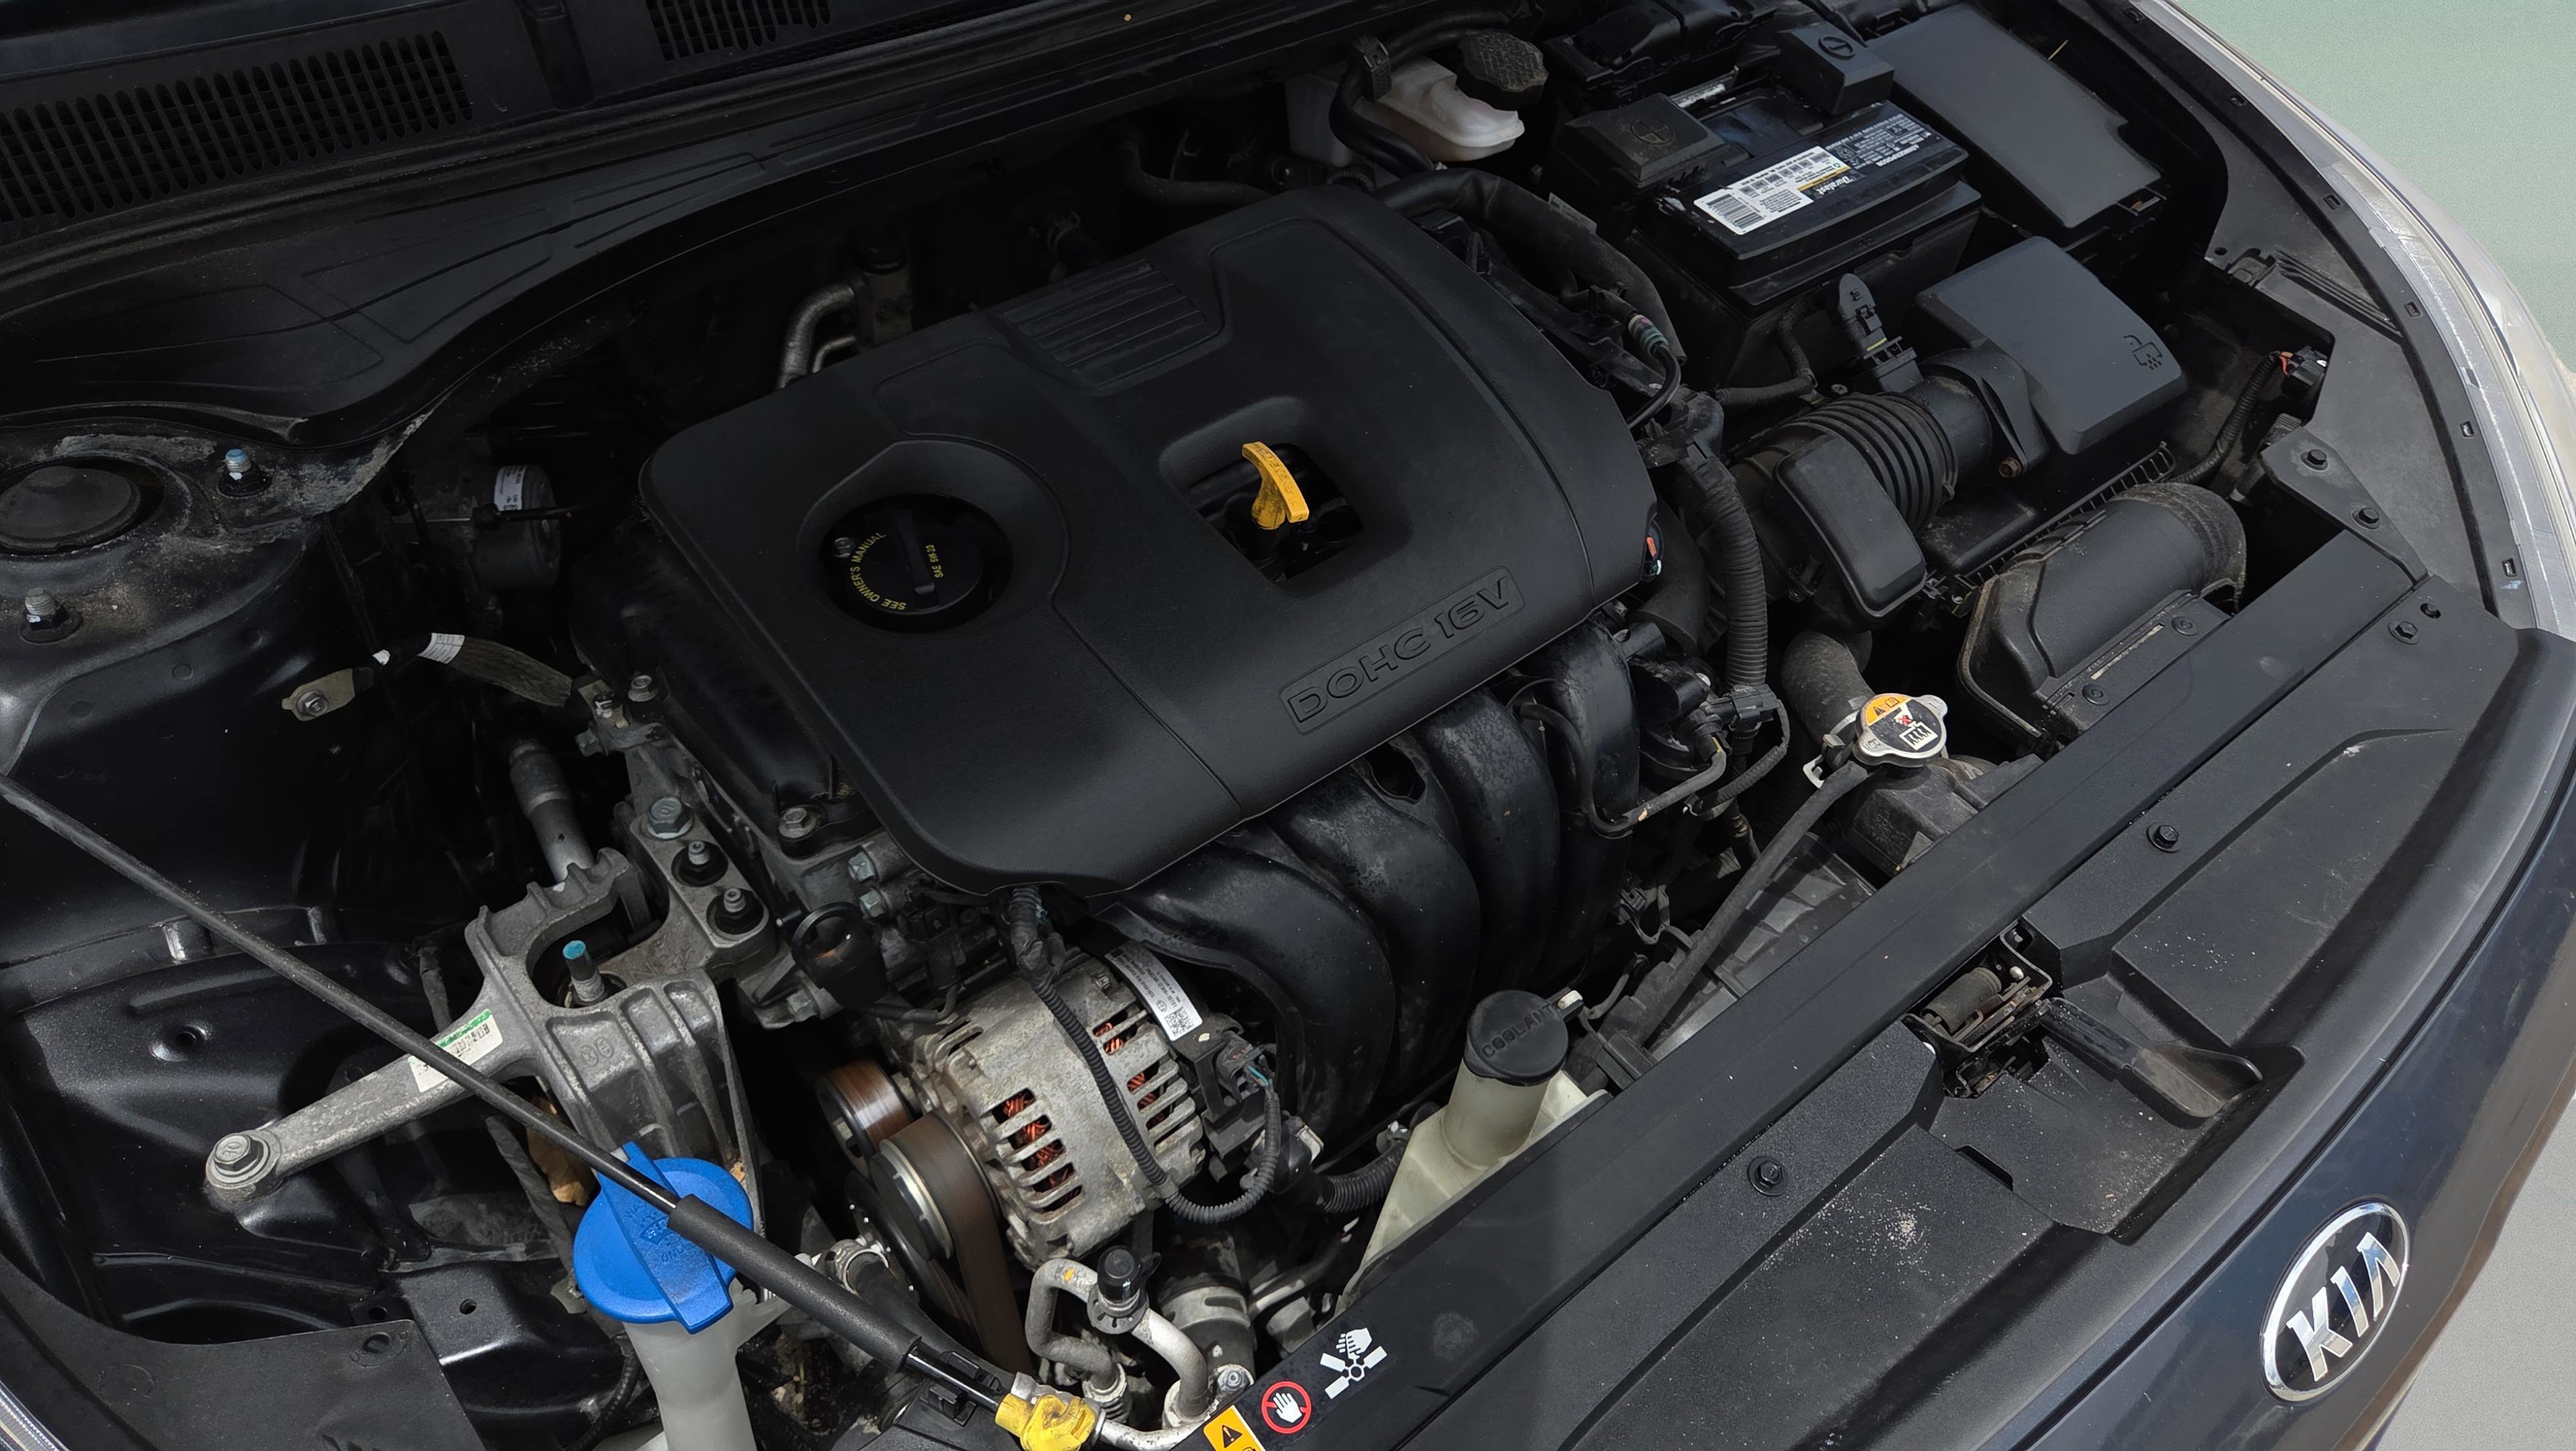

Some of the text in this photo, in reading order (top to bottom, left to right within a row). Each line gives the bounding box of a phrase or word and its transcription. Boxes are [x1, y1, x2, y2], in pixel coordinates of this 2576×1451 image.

[1815, 175, 1853, 195] Duralast
[849, 531, 907, 611] SEE OWNER'S MANUAL
[931, 564, 944, 578] SAE
[1286, 575, 1510, 724] DOHC 16V
[1481, 1004, 1555, 1059] COOLANT
[2285, 1231, 2401, 1382] KIA
